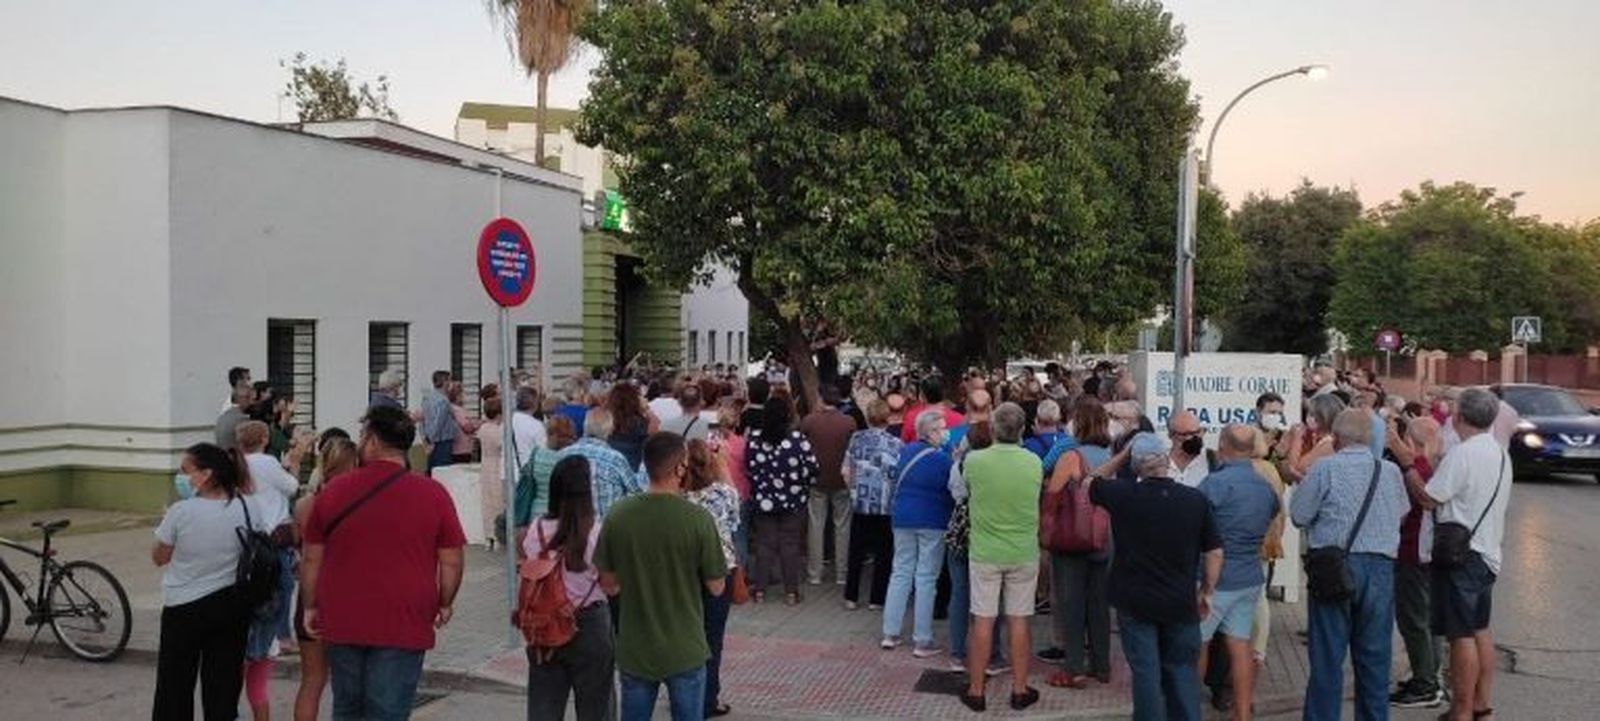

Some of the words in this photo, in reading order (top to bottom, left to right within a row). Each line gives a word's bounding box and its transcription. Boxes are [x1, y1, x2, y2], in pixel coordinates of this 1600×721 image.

[1185, 376, 1234, 393] MADRE
[1157, 406, 1211, 424] RA
[1218, 408, 1287, 425] USA
